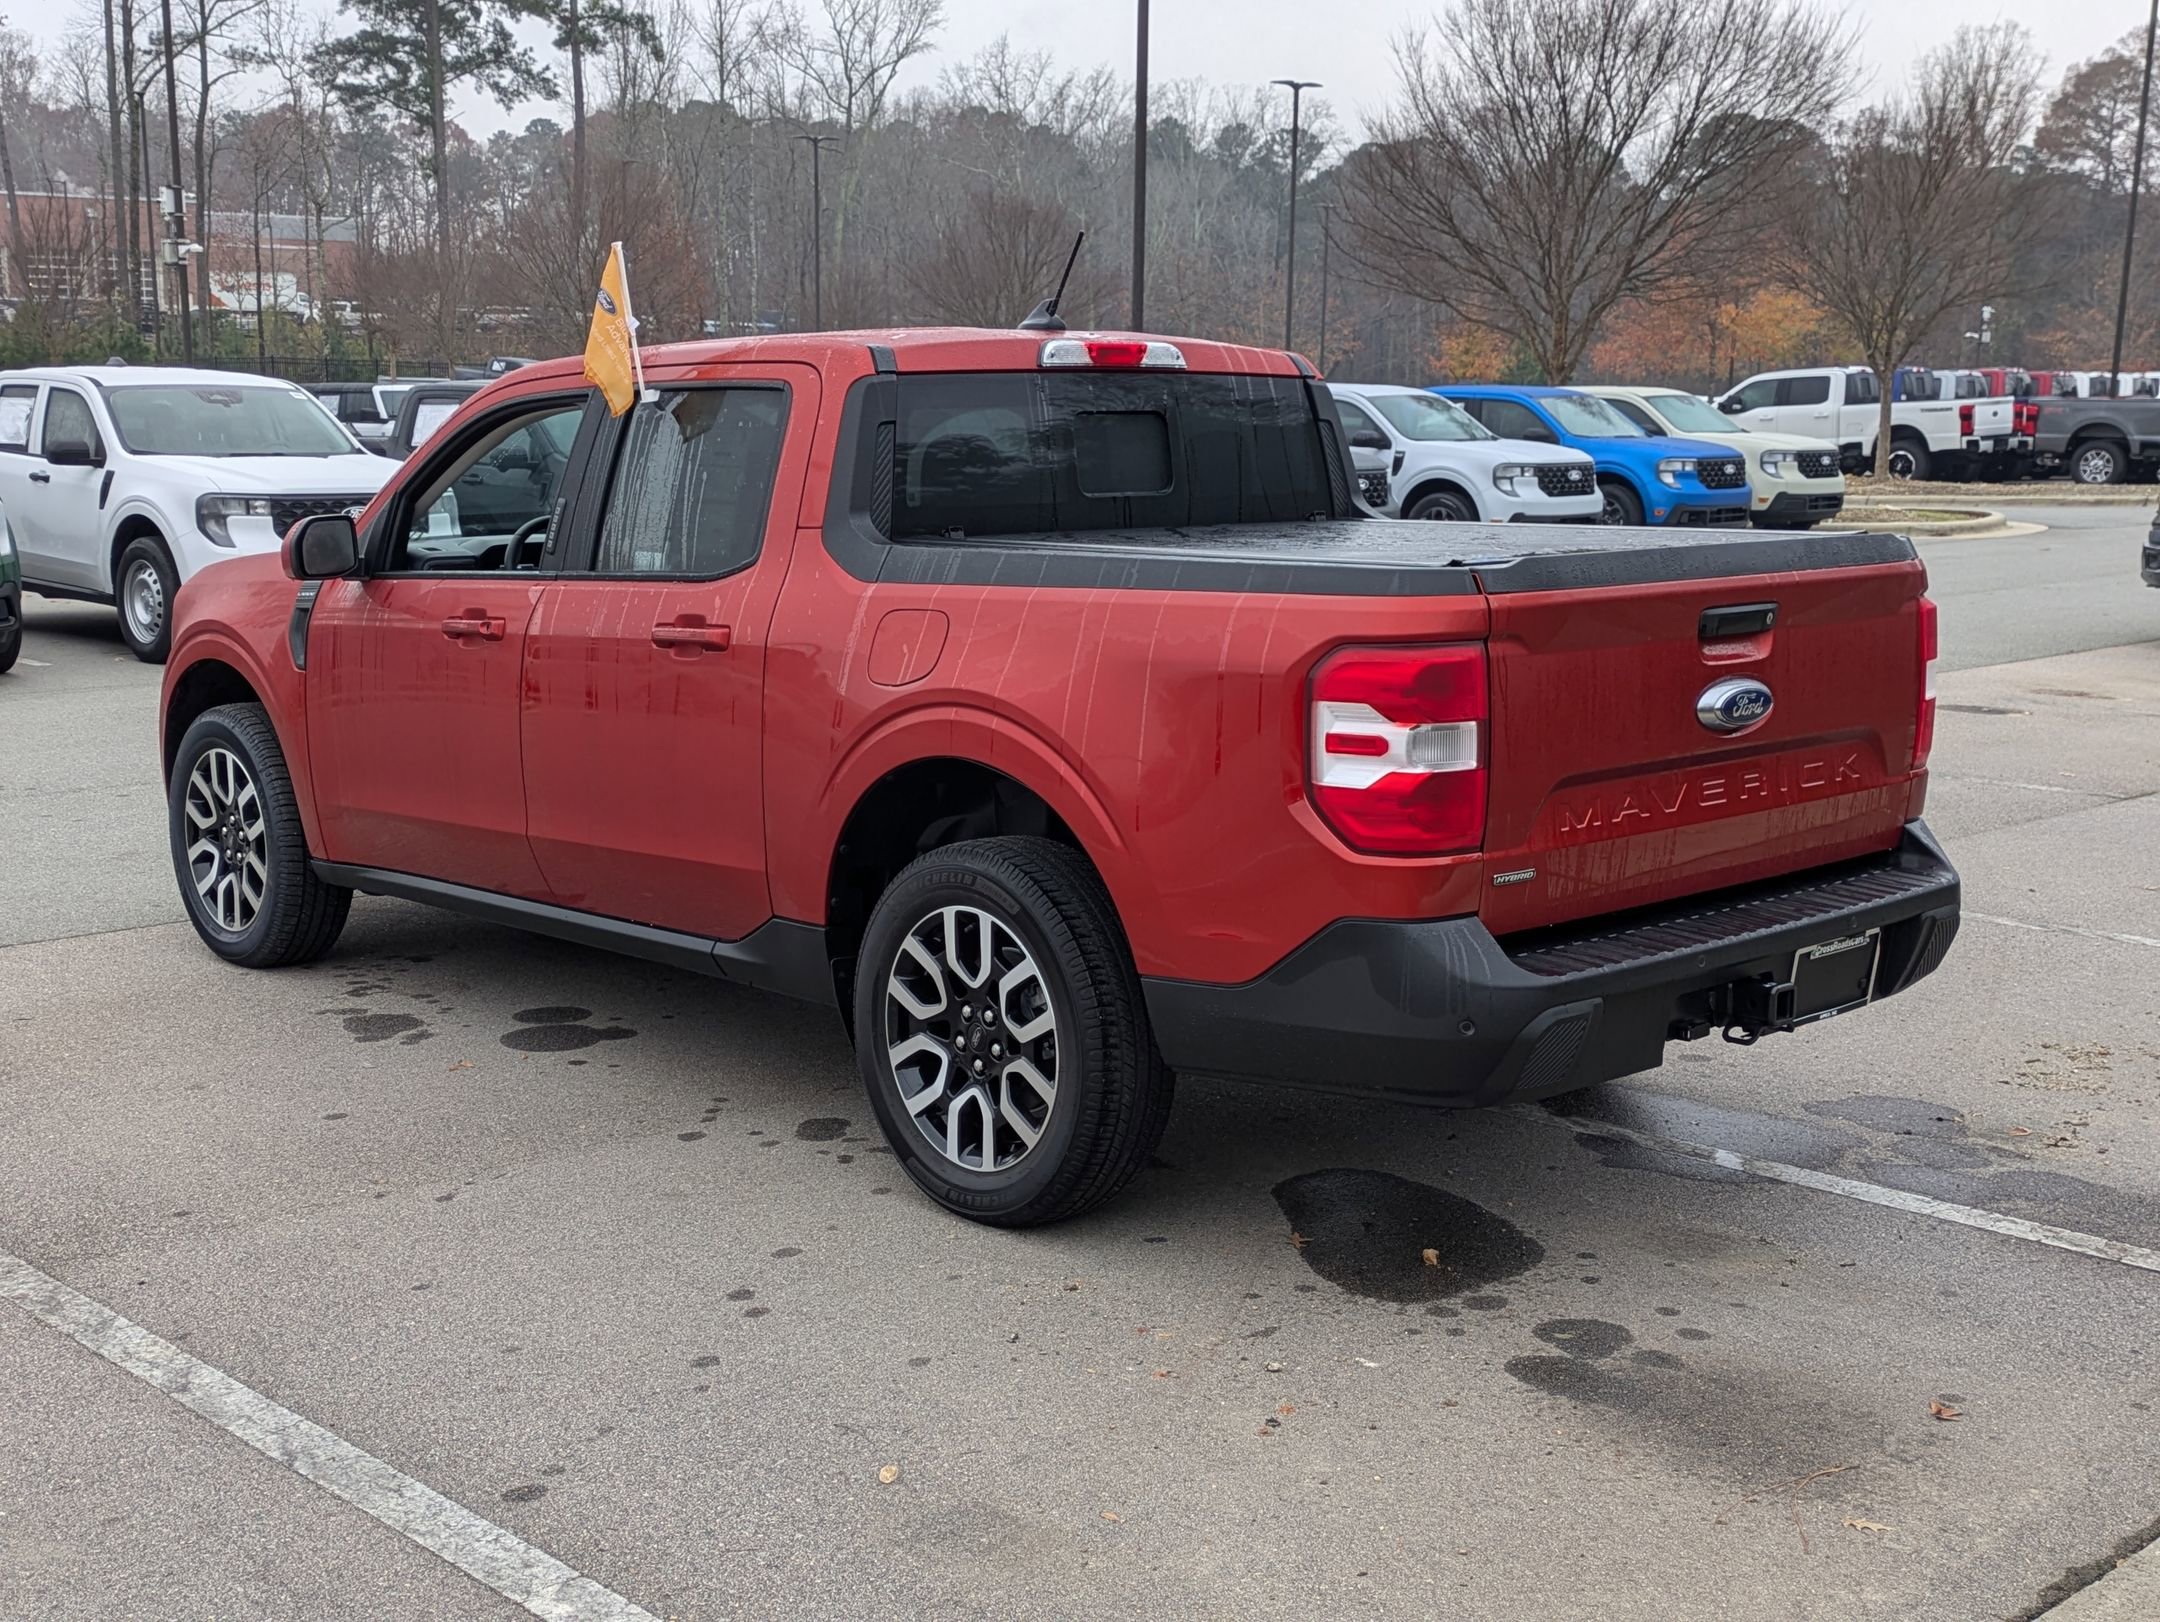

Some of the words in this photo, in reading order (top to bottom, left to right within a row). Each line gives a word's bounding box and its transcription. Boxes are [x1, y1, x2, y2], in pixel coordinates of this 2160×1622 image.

[1733, 693, 1764, 717] Ford
[1561, 753, 1861, 831] MAVERICK
[1496, 871, 1534, 884] HYBRID
